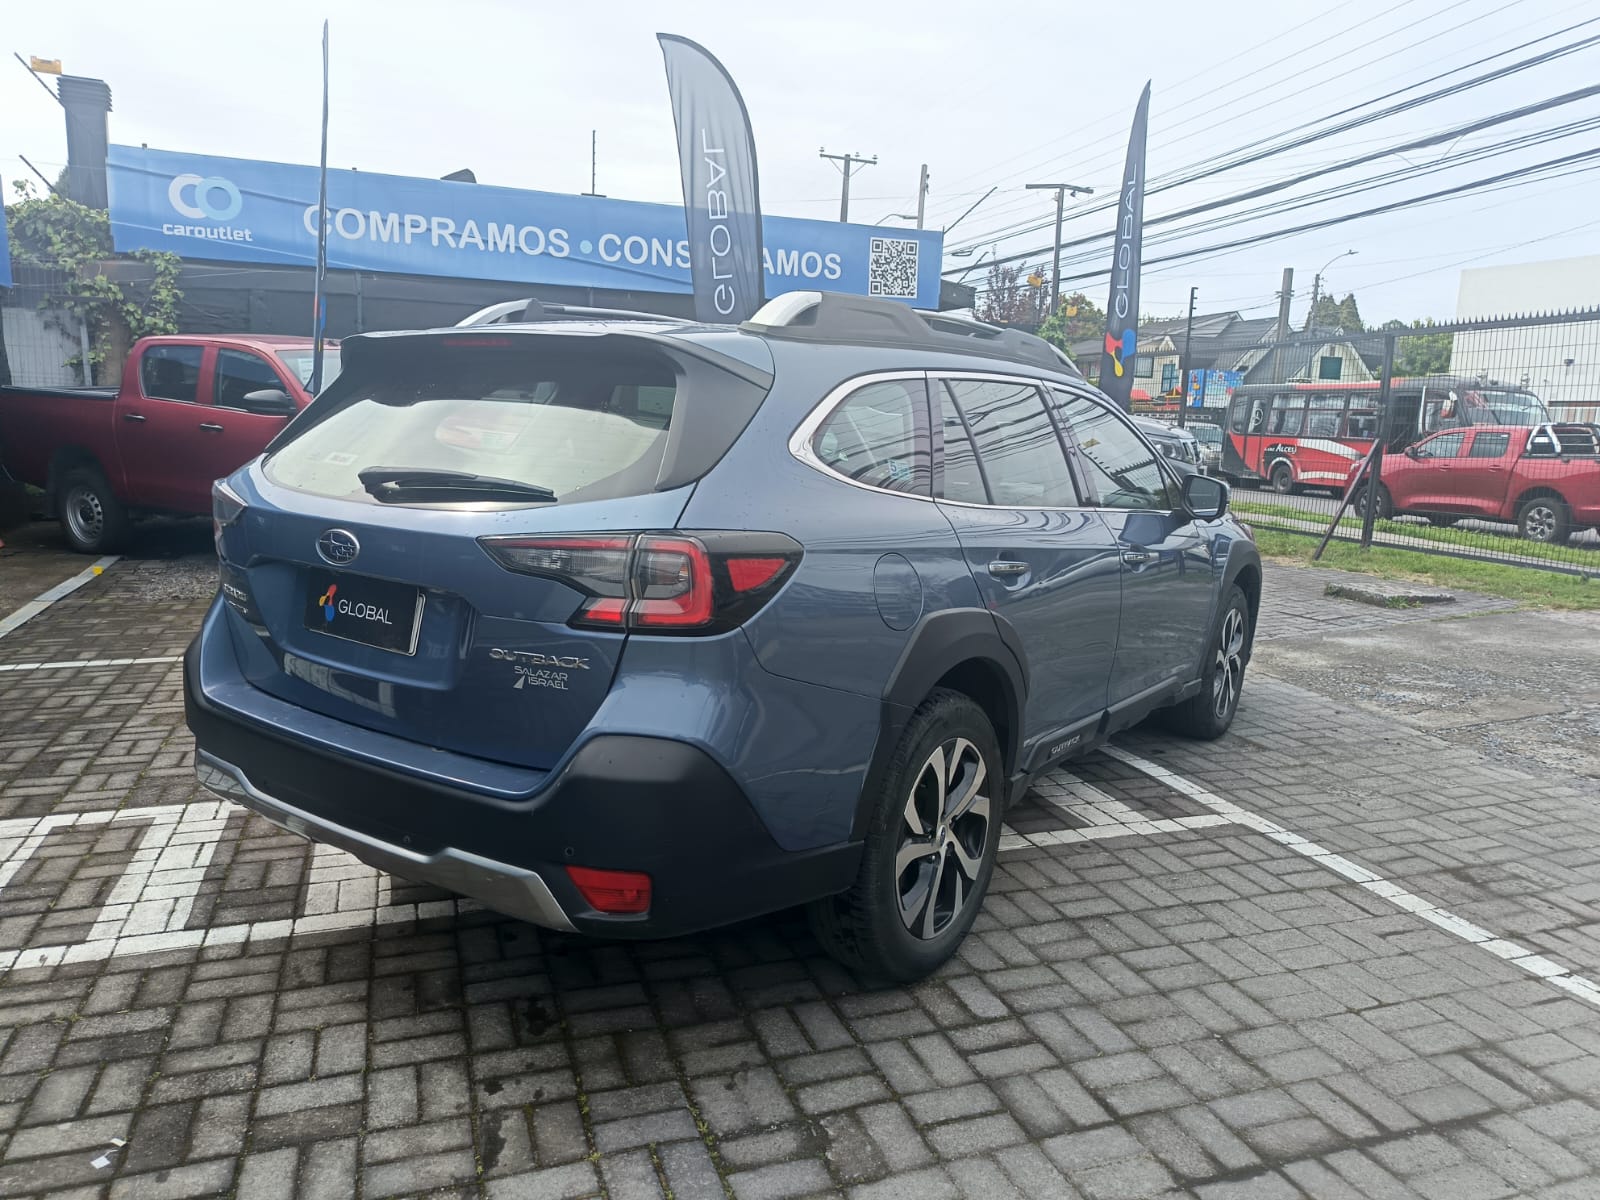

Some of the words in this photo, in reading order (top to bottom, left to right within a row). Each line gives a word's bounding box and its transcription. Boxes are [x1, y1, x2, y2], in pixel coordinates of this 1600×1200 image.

[162, 223, 253, 242] caroutlet
[303, 204, 570, 258] COMPRAMOS
[598, 233, 842, 280] CONSAMOS
[1115, 163, 1137, 319] GLOBAL
[338, 599, 393, 625] GLOBAL
[489, 648, 590, 669] OUTBACK
[514, 665, 568, 682] SALAZAR
[528, 676, 569, 690] ISRAEL
